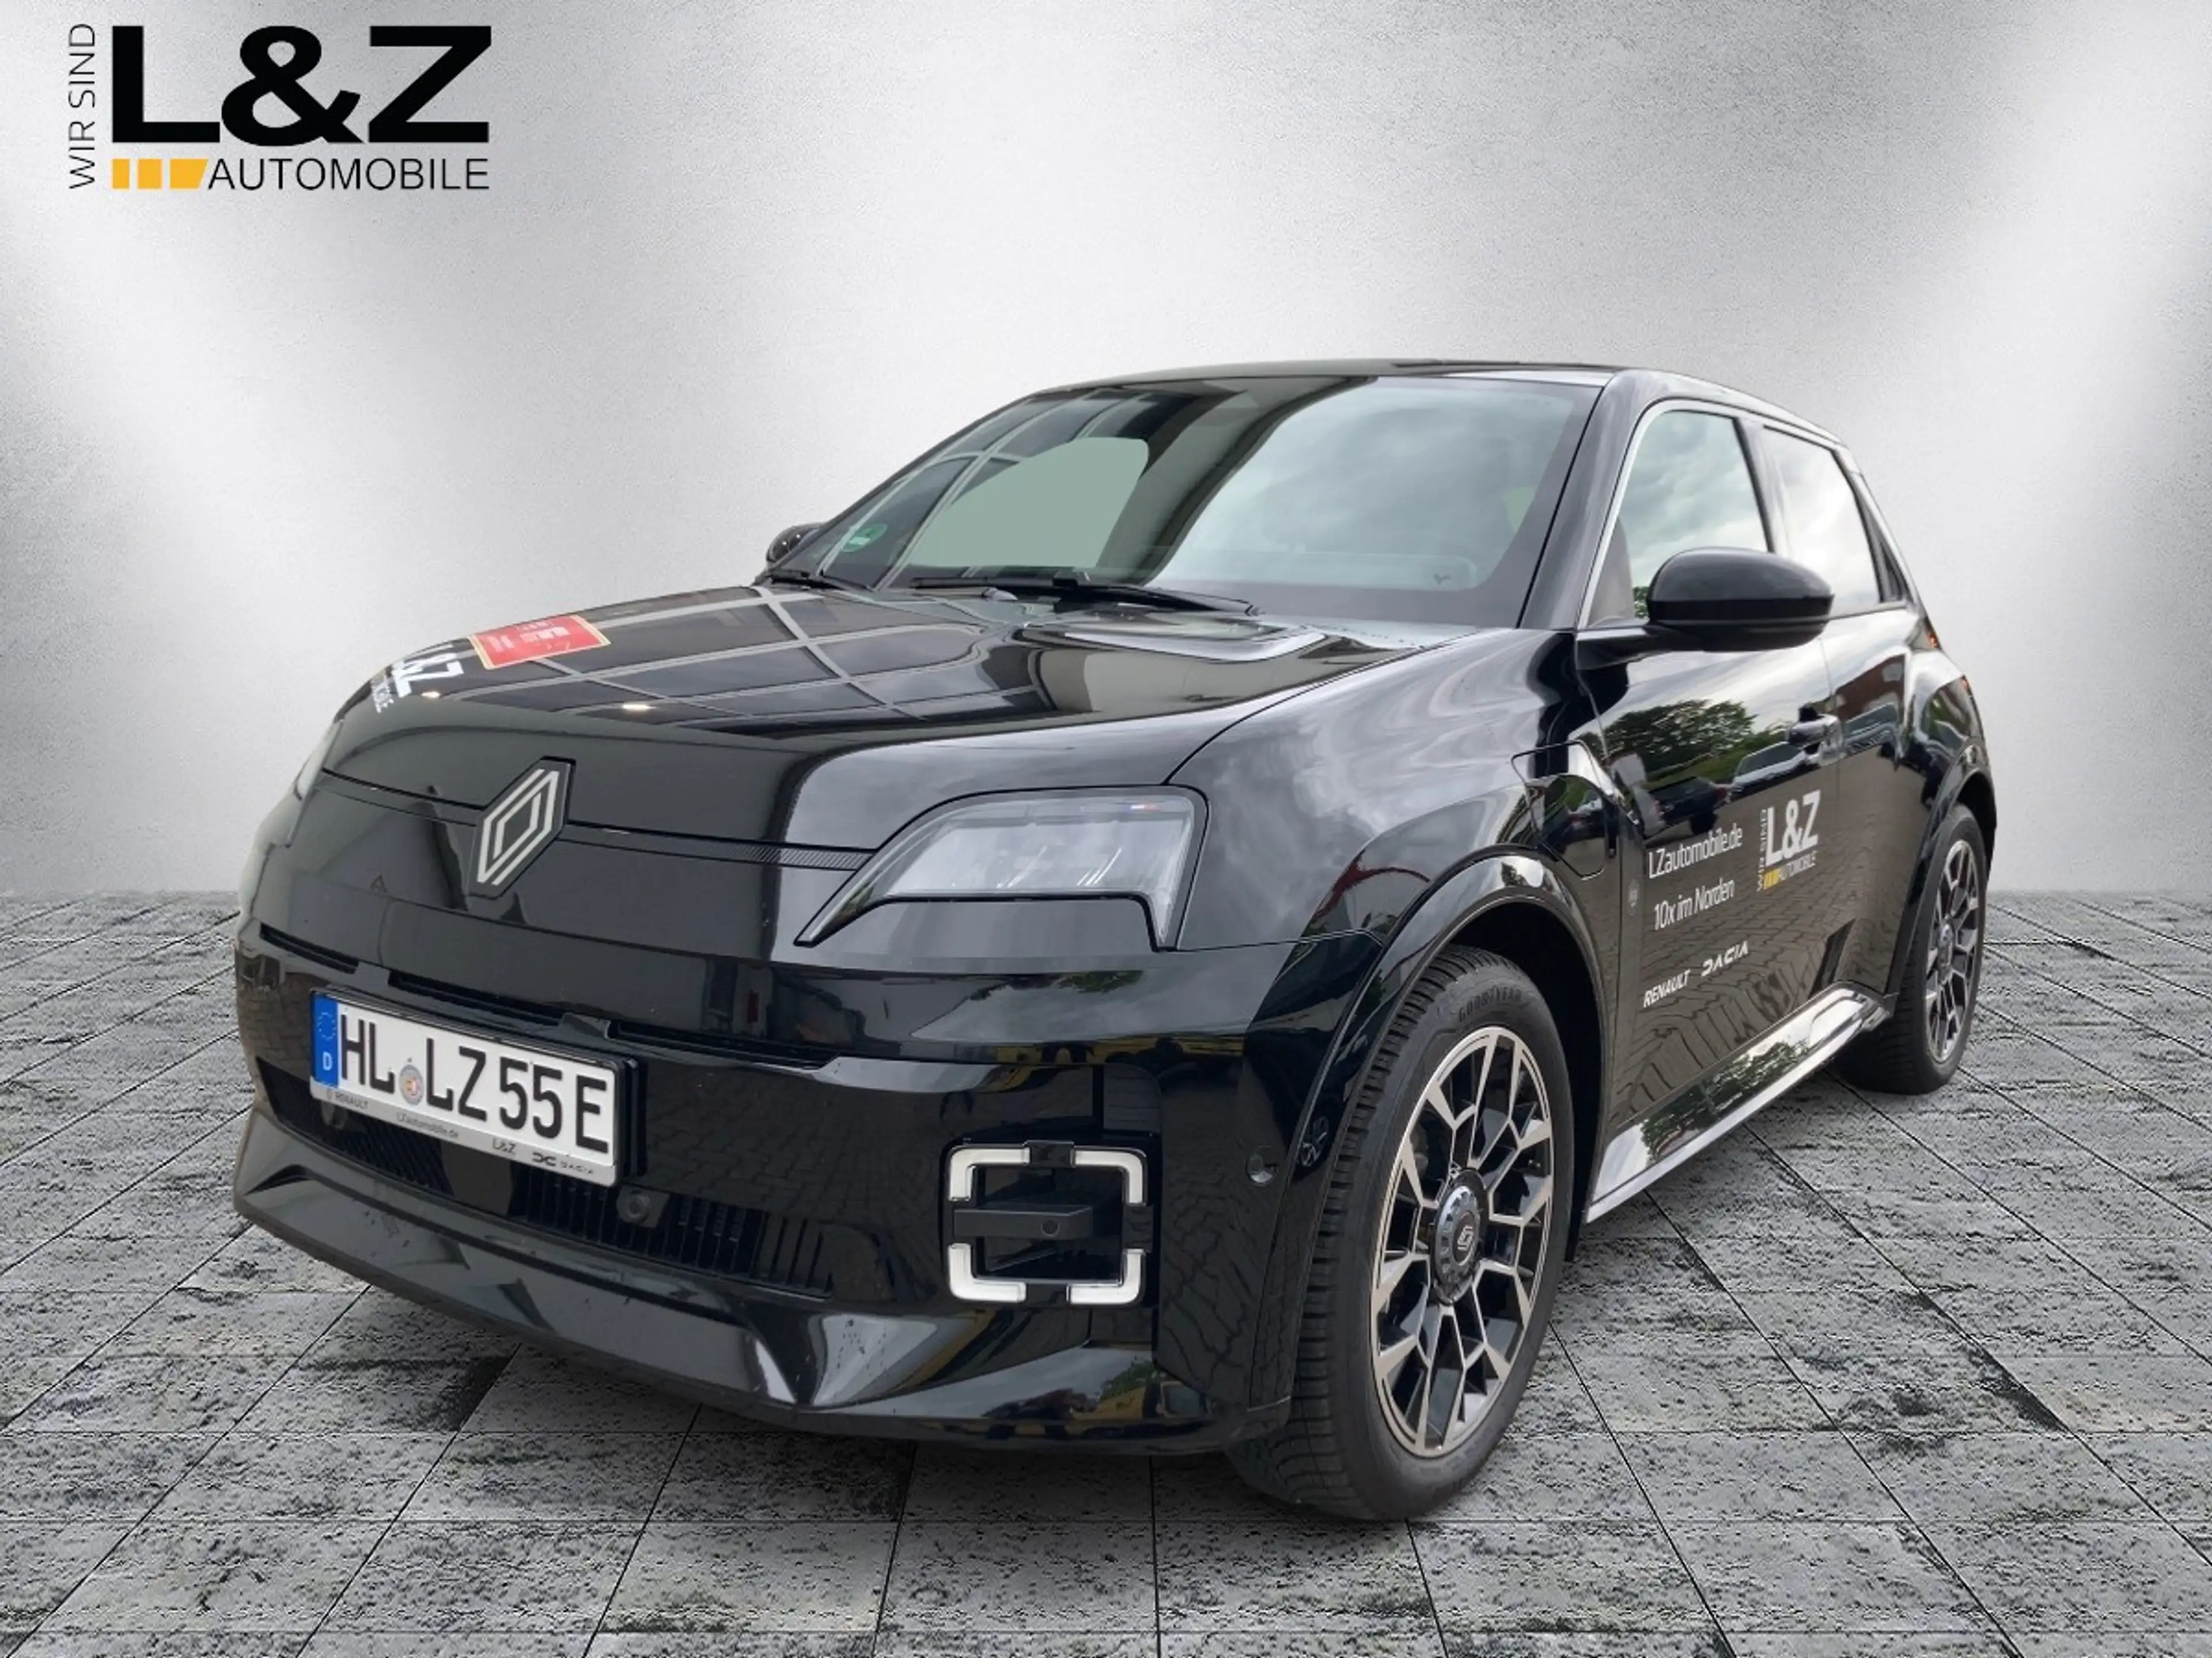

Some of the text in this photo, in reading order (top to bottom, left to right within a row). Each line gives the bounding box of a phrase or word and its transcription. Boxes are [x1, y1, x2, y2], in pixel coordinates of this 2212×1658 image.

[1649, 822, 1743, 879] LZautomobile.de
[1766, 790, 1821, 866] L&Z
[1654, 877, 1735, 931] 10x im Norden
[1643, 940, 1749, 1008] RENAULT DACIA
[323, 1051, 333, 1070] D
[340, 1014, 395, 1093] HL
